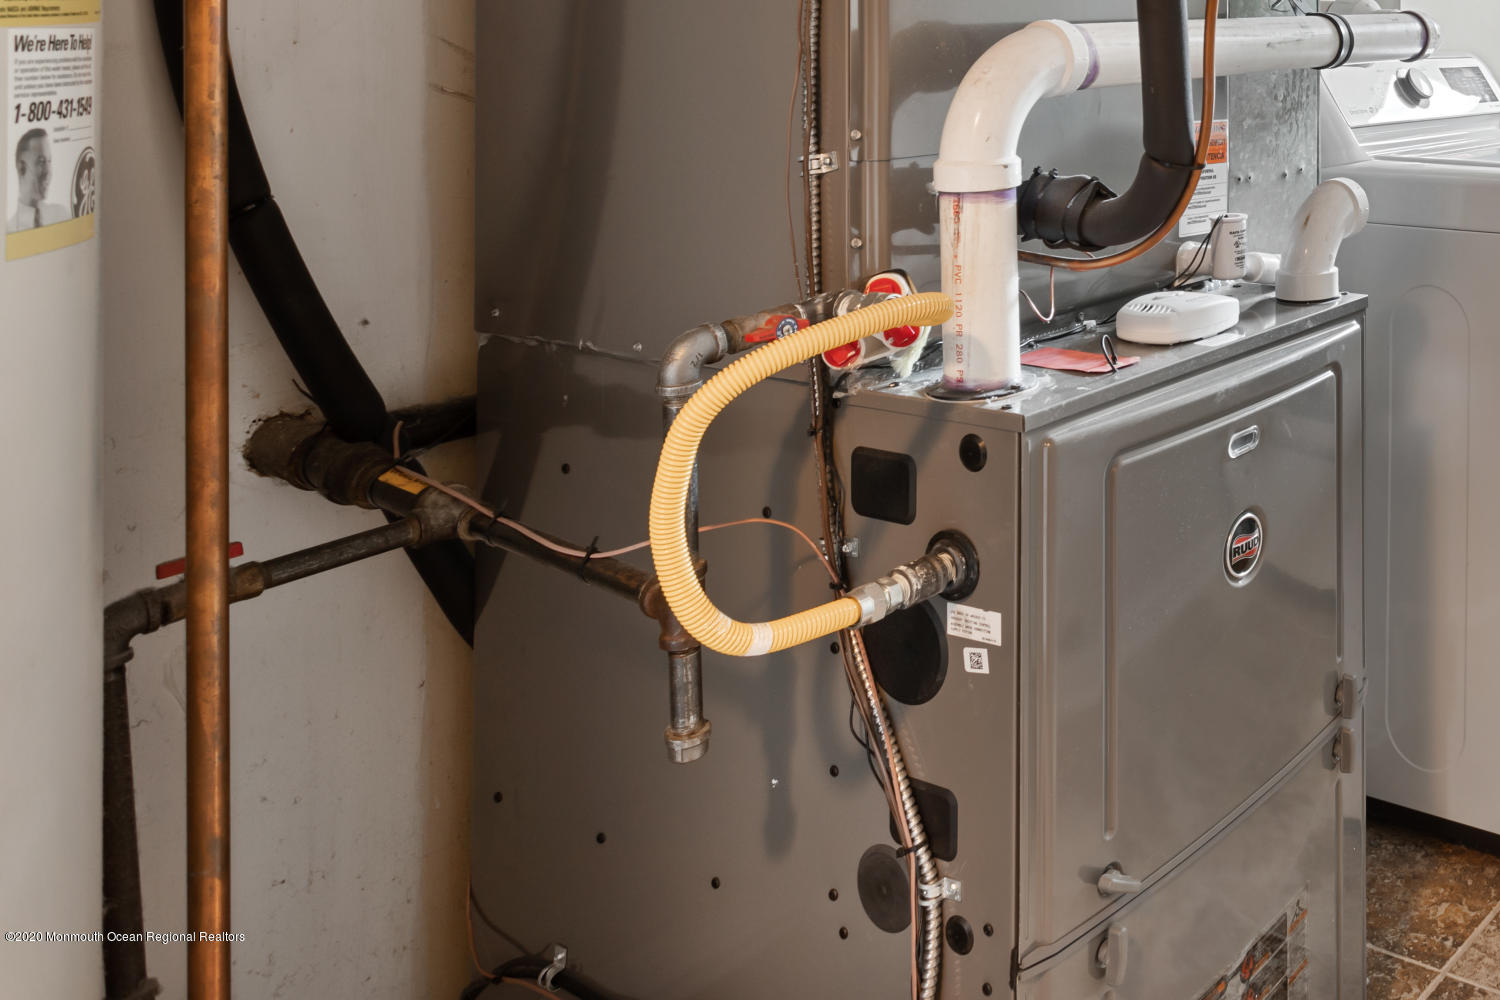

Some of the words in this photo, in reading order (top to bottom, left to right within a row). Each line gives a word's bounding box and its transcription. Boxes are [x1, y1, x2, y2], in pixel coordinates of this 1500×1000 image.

[14, 34, 46, 52] We're
[48, 34, 69, 52] Here
[70, 34, 77, 51] To
[954, 264, 962, 285] PVC
[955, 292, 963, 318] 1120
[955, 323, 963, 337] PR
[955, 343, 964, 364] 280
[1233, 536, 1259, 558] RUUD
